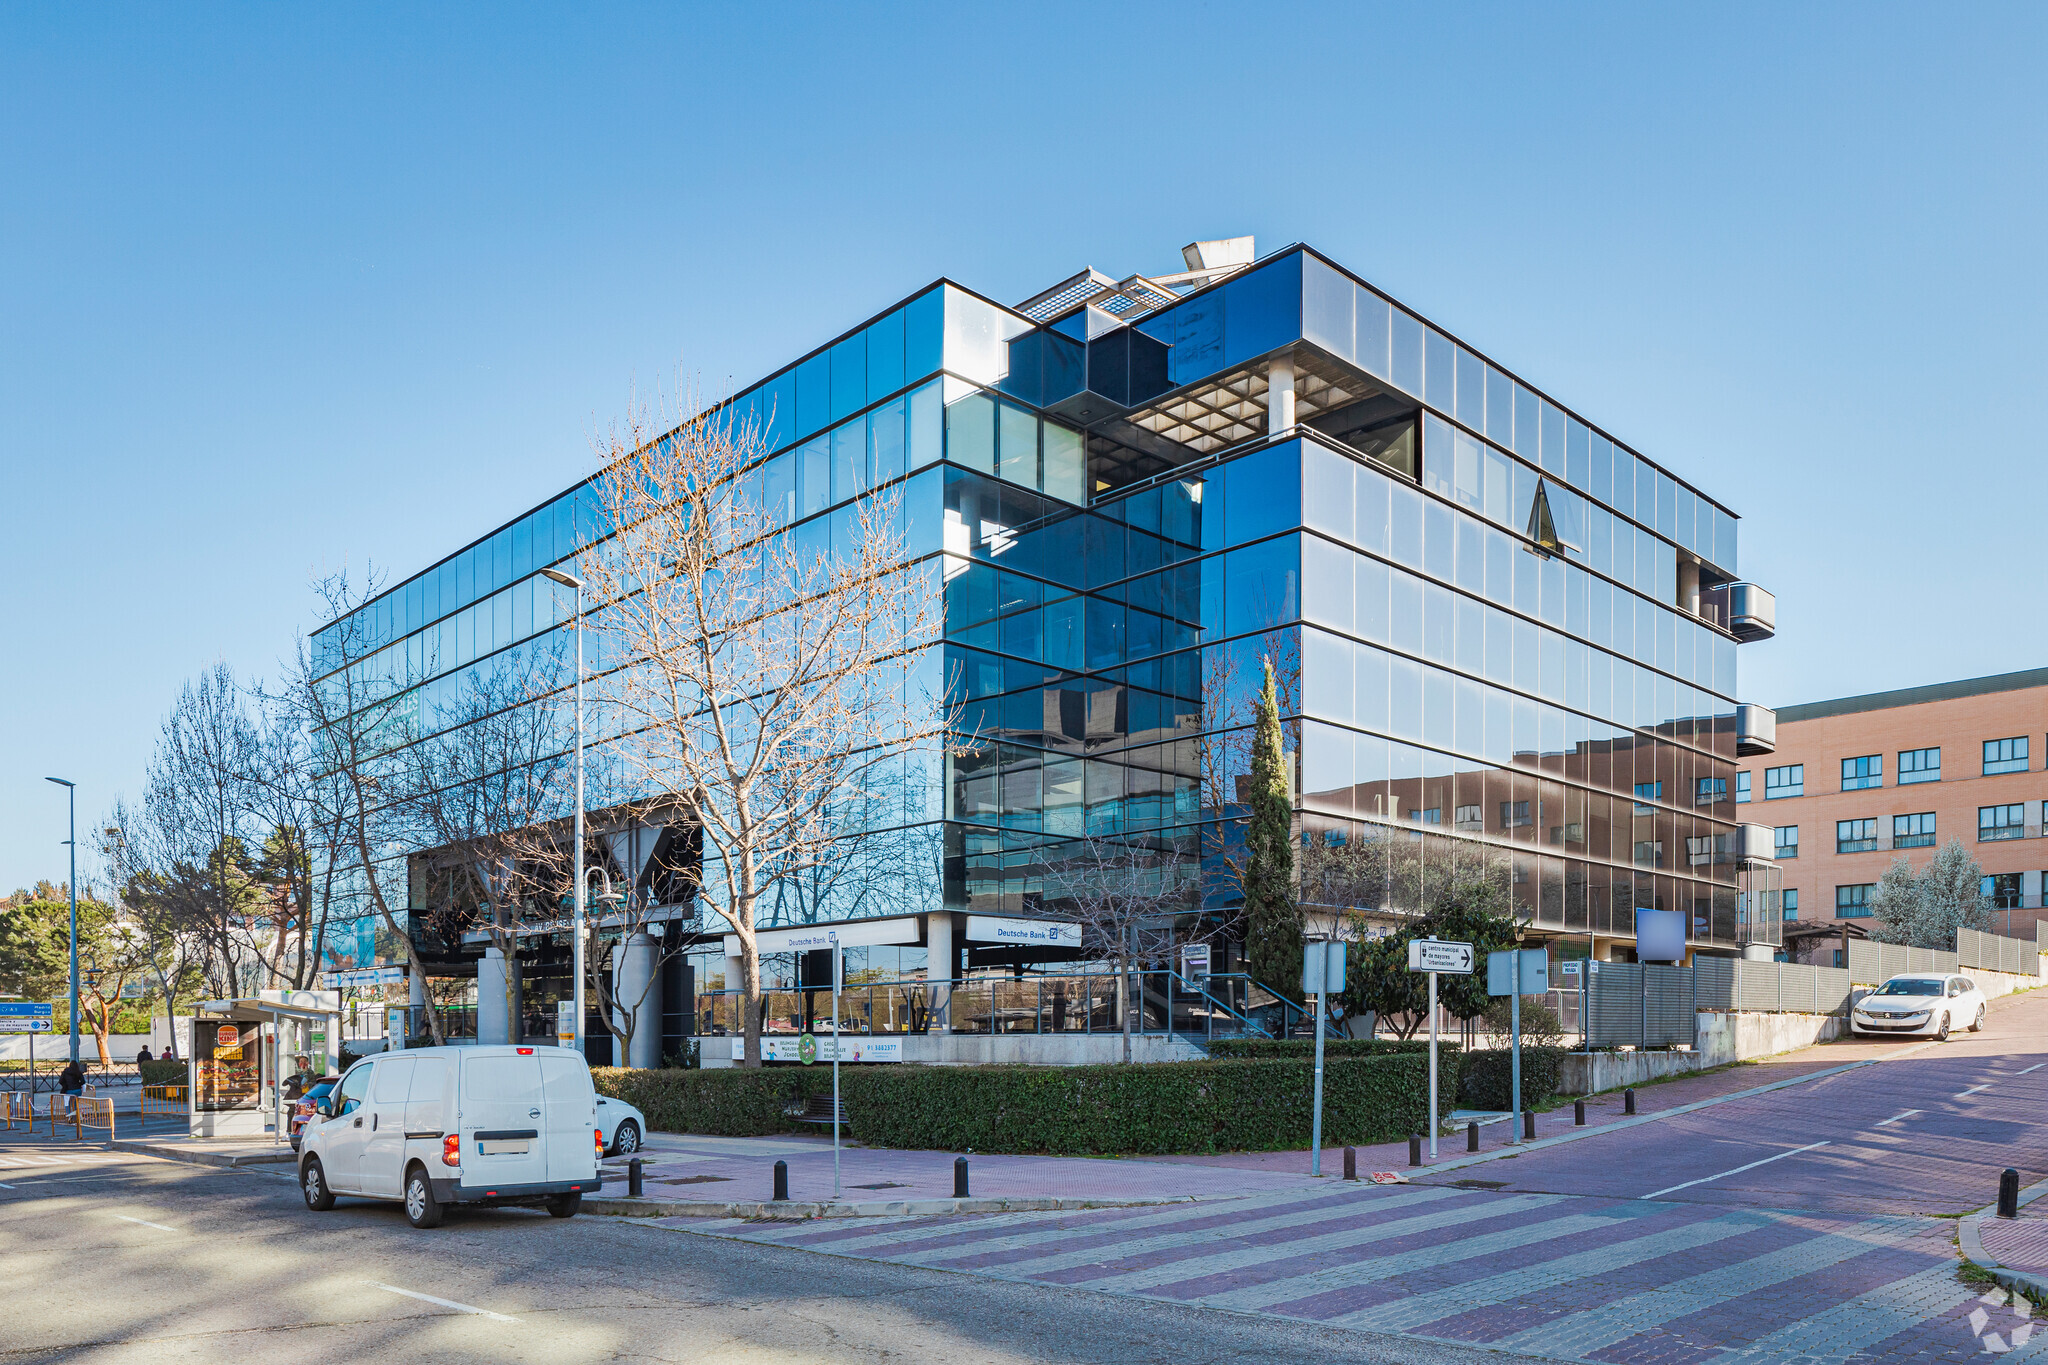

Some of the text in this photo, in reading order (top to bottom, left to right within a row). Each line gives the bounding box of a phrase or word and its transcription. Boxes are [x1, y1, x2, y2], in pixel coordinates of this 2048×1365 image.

[997, 928, 1046, 939] Deutsche Bank
[788, 936, 826, 947] Deutsche Bank
[213, 1046, 243, 1060] QUEEN
